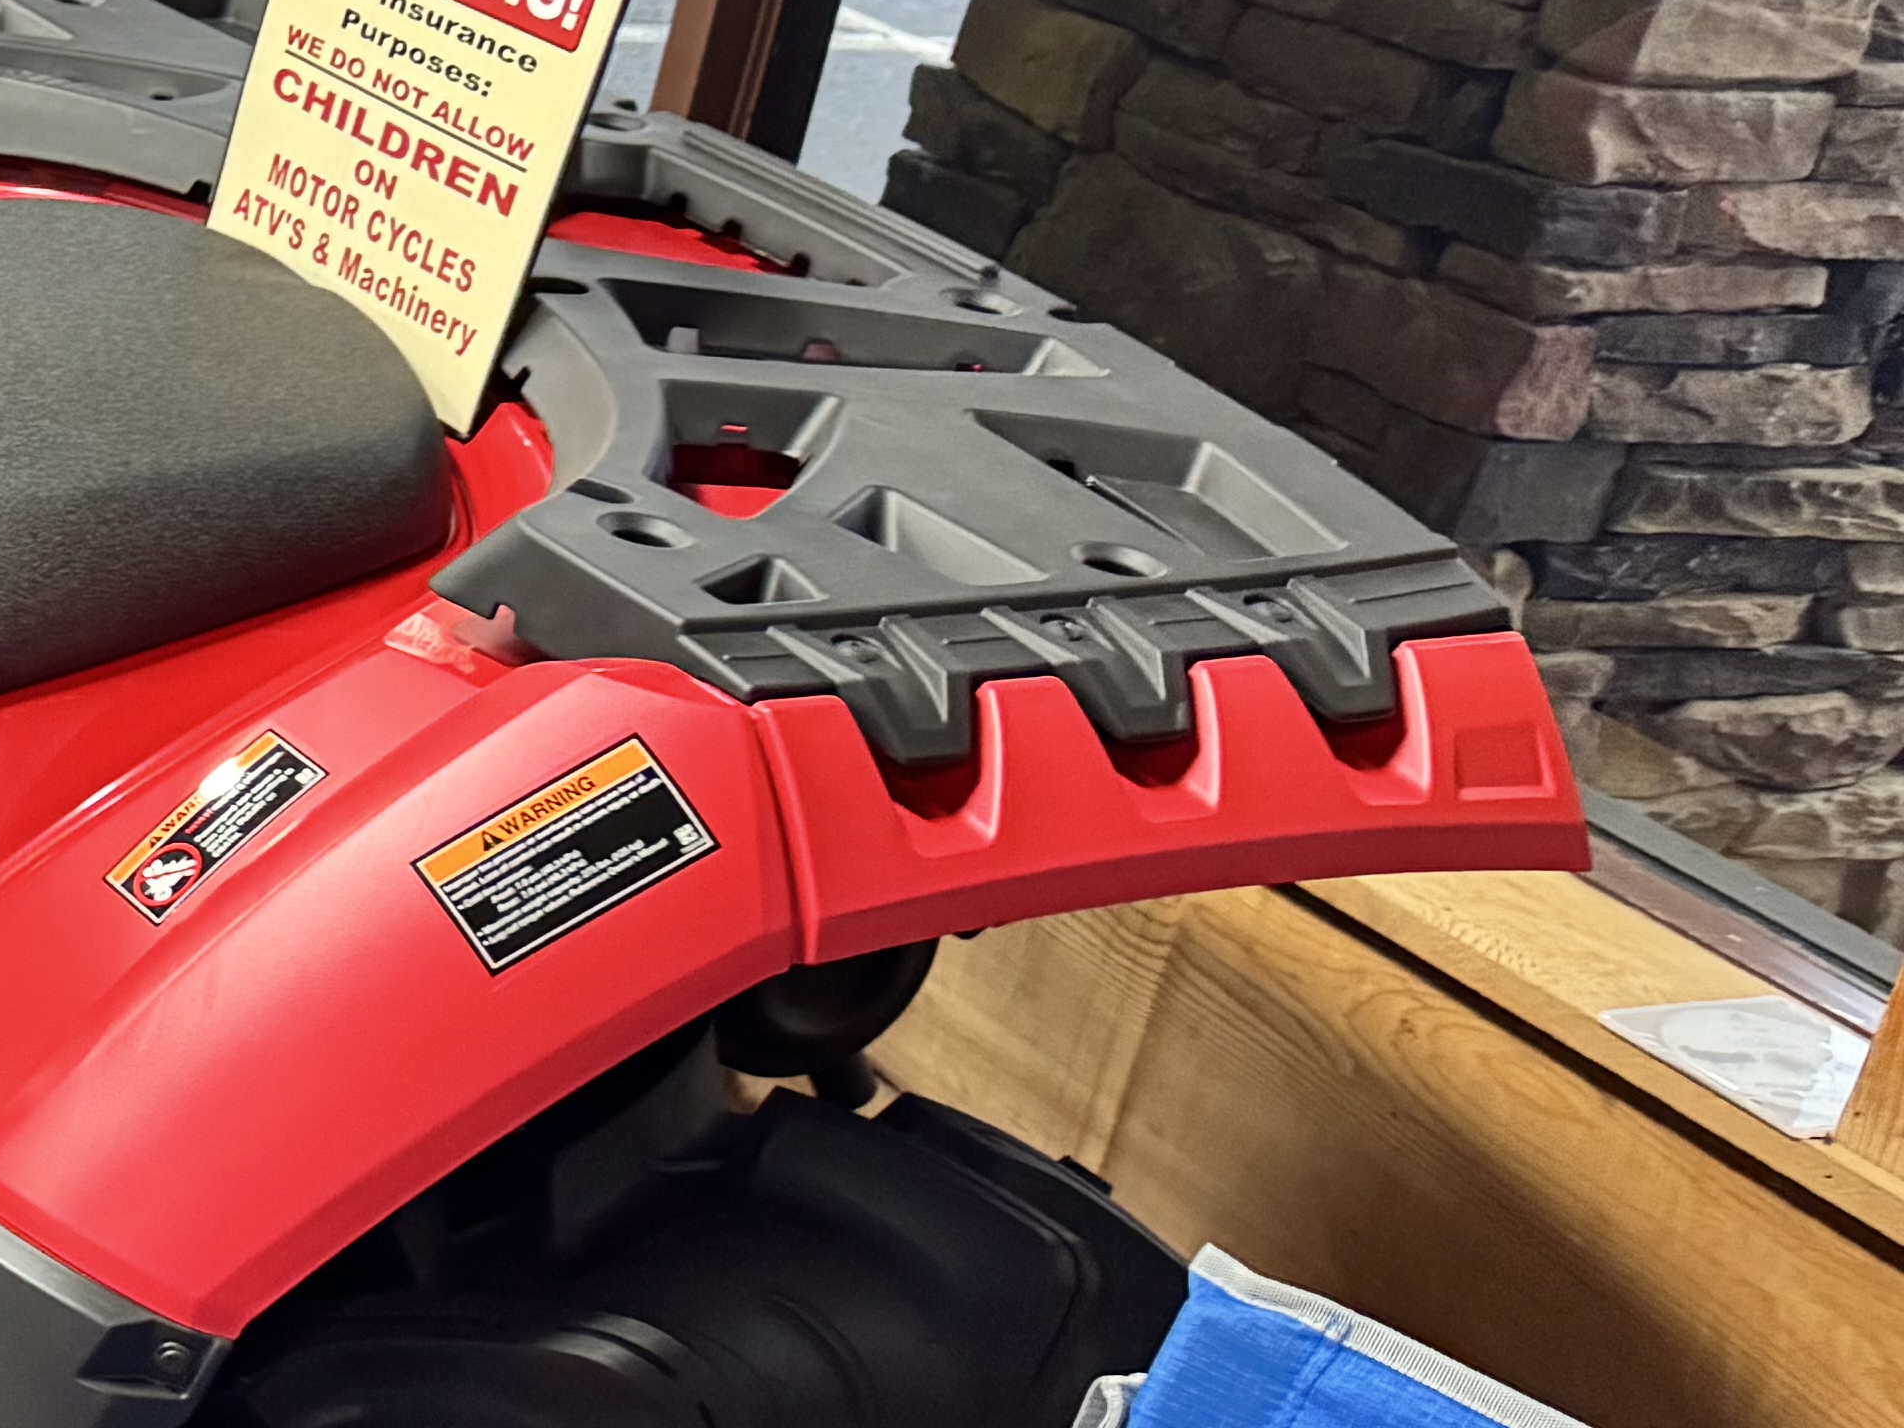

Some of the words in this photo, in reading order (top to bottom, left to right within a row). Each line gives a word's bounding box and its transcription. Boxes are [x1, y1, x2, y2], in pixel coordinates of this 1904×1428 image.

[288, 24, 324, 59] WE
[329, 47, 366, 79] DO
[372, 68, 430, 109] NOT
[431, 100, 535, 162] ALLOW
[341, 8, 492, 98] Purposes:
[273, 67, 519, 218] CHILDREN
[354, 159, 399, 200] ON
[232, 188, 306, 250] ATV'S
[312, 232, 331, 267] &
[338, 246, 478, 357] Machinery
[267, 153, 360, 229] MOTOR
[366, 209, 477, 293] CYCLES
[499, 775, 597, 836] WARNING
